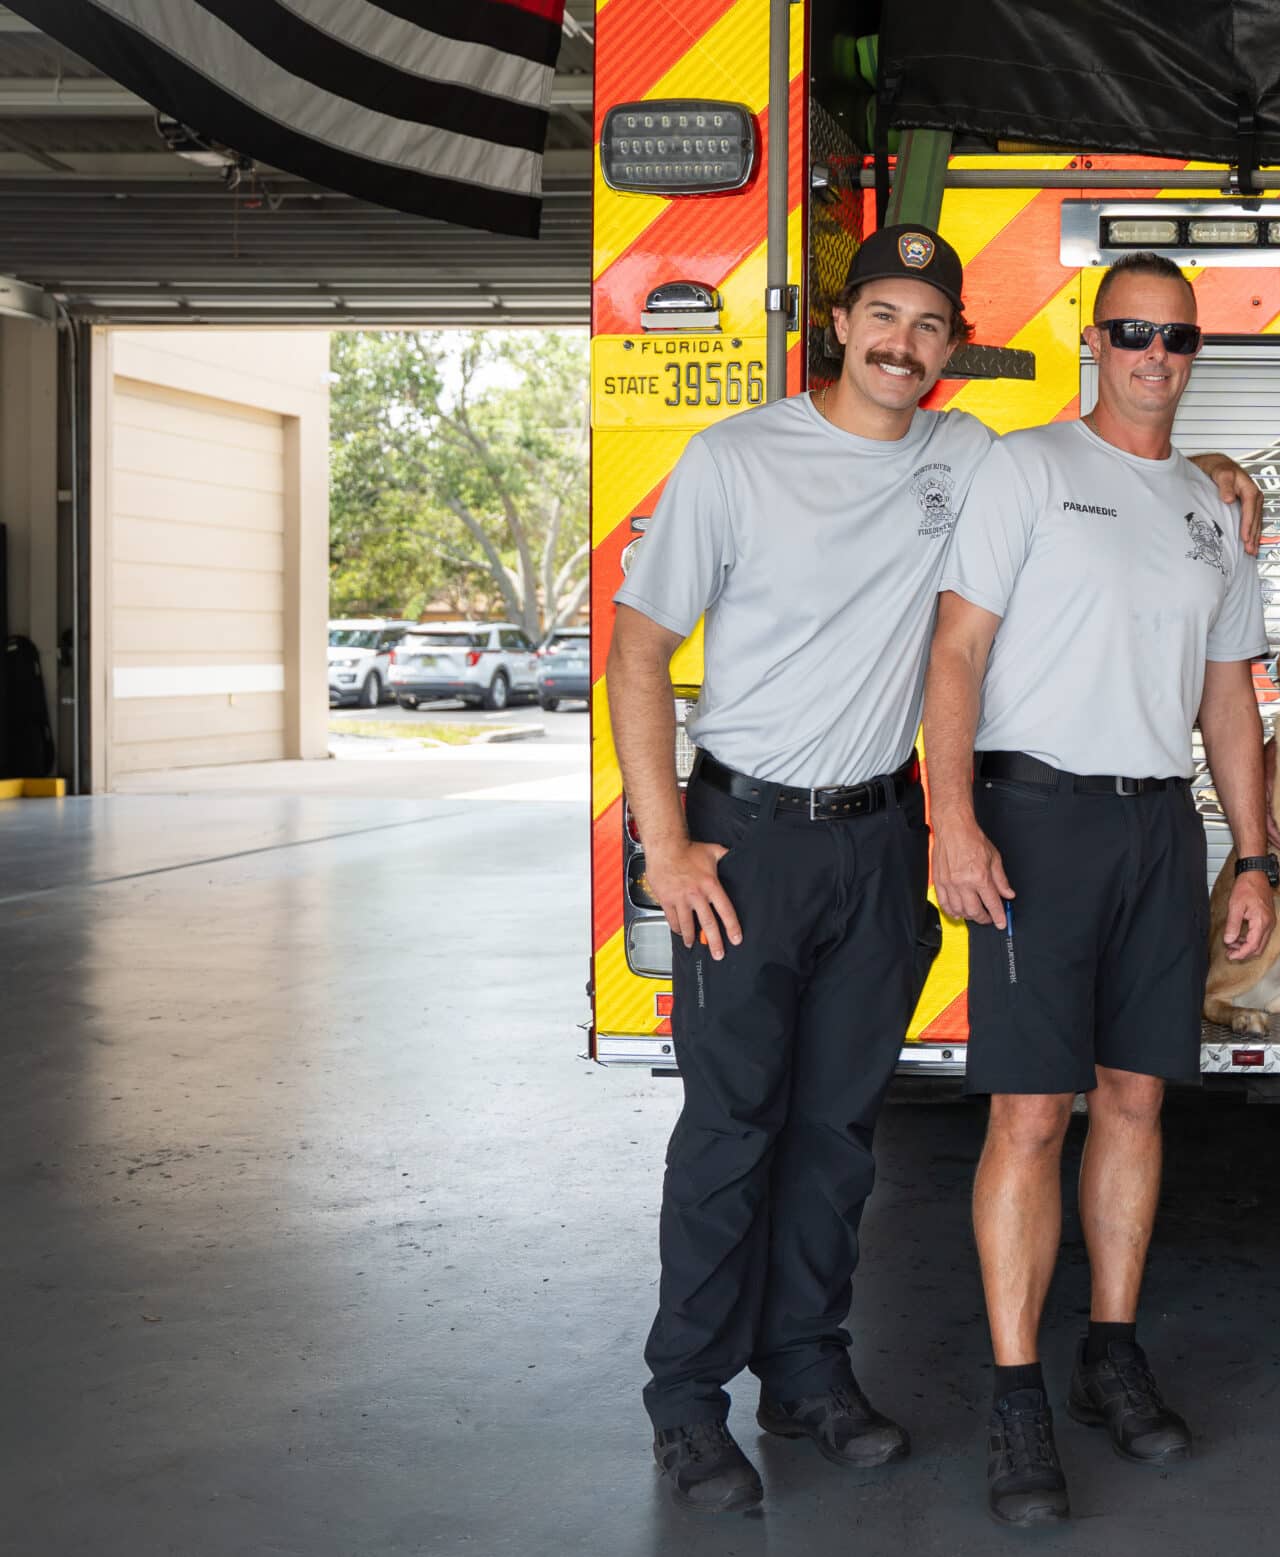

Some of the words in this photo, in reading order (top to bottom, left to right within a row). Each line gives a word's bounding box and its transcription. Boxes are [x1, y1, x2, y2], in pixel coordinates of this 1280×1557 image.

[641, 340, 724, 354] FLORIDA
[604, 376, 660, 395] STATE
[664, 360, 764, 406] 39566
[1063, 501, 1118, 518] PARAMEDIC
